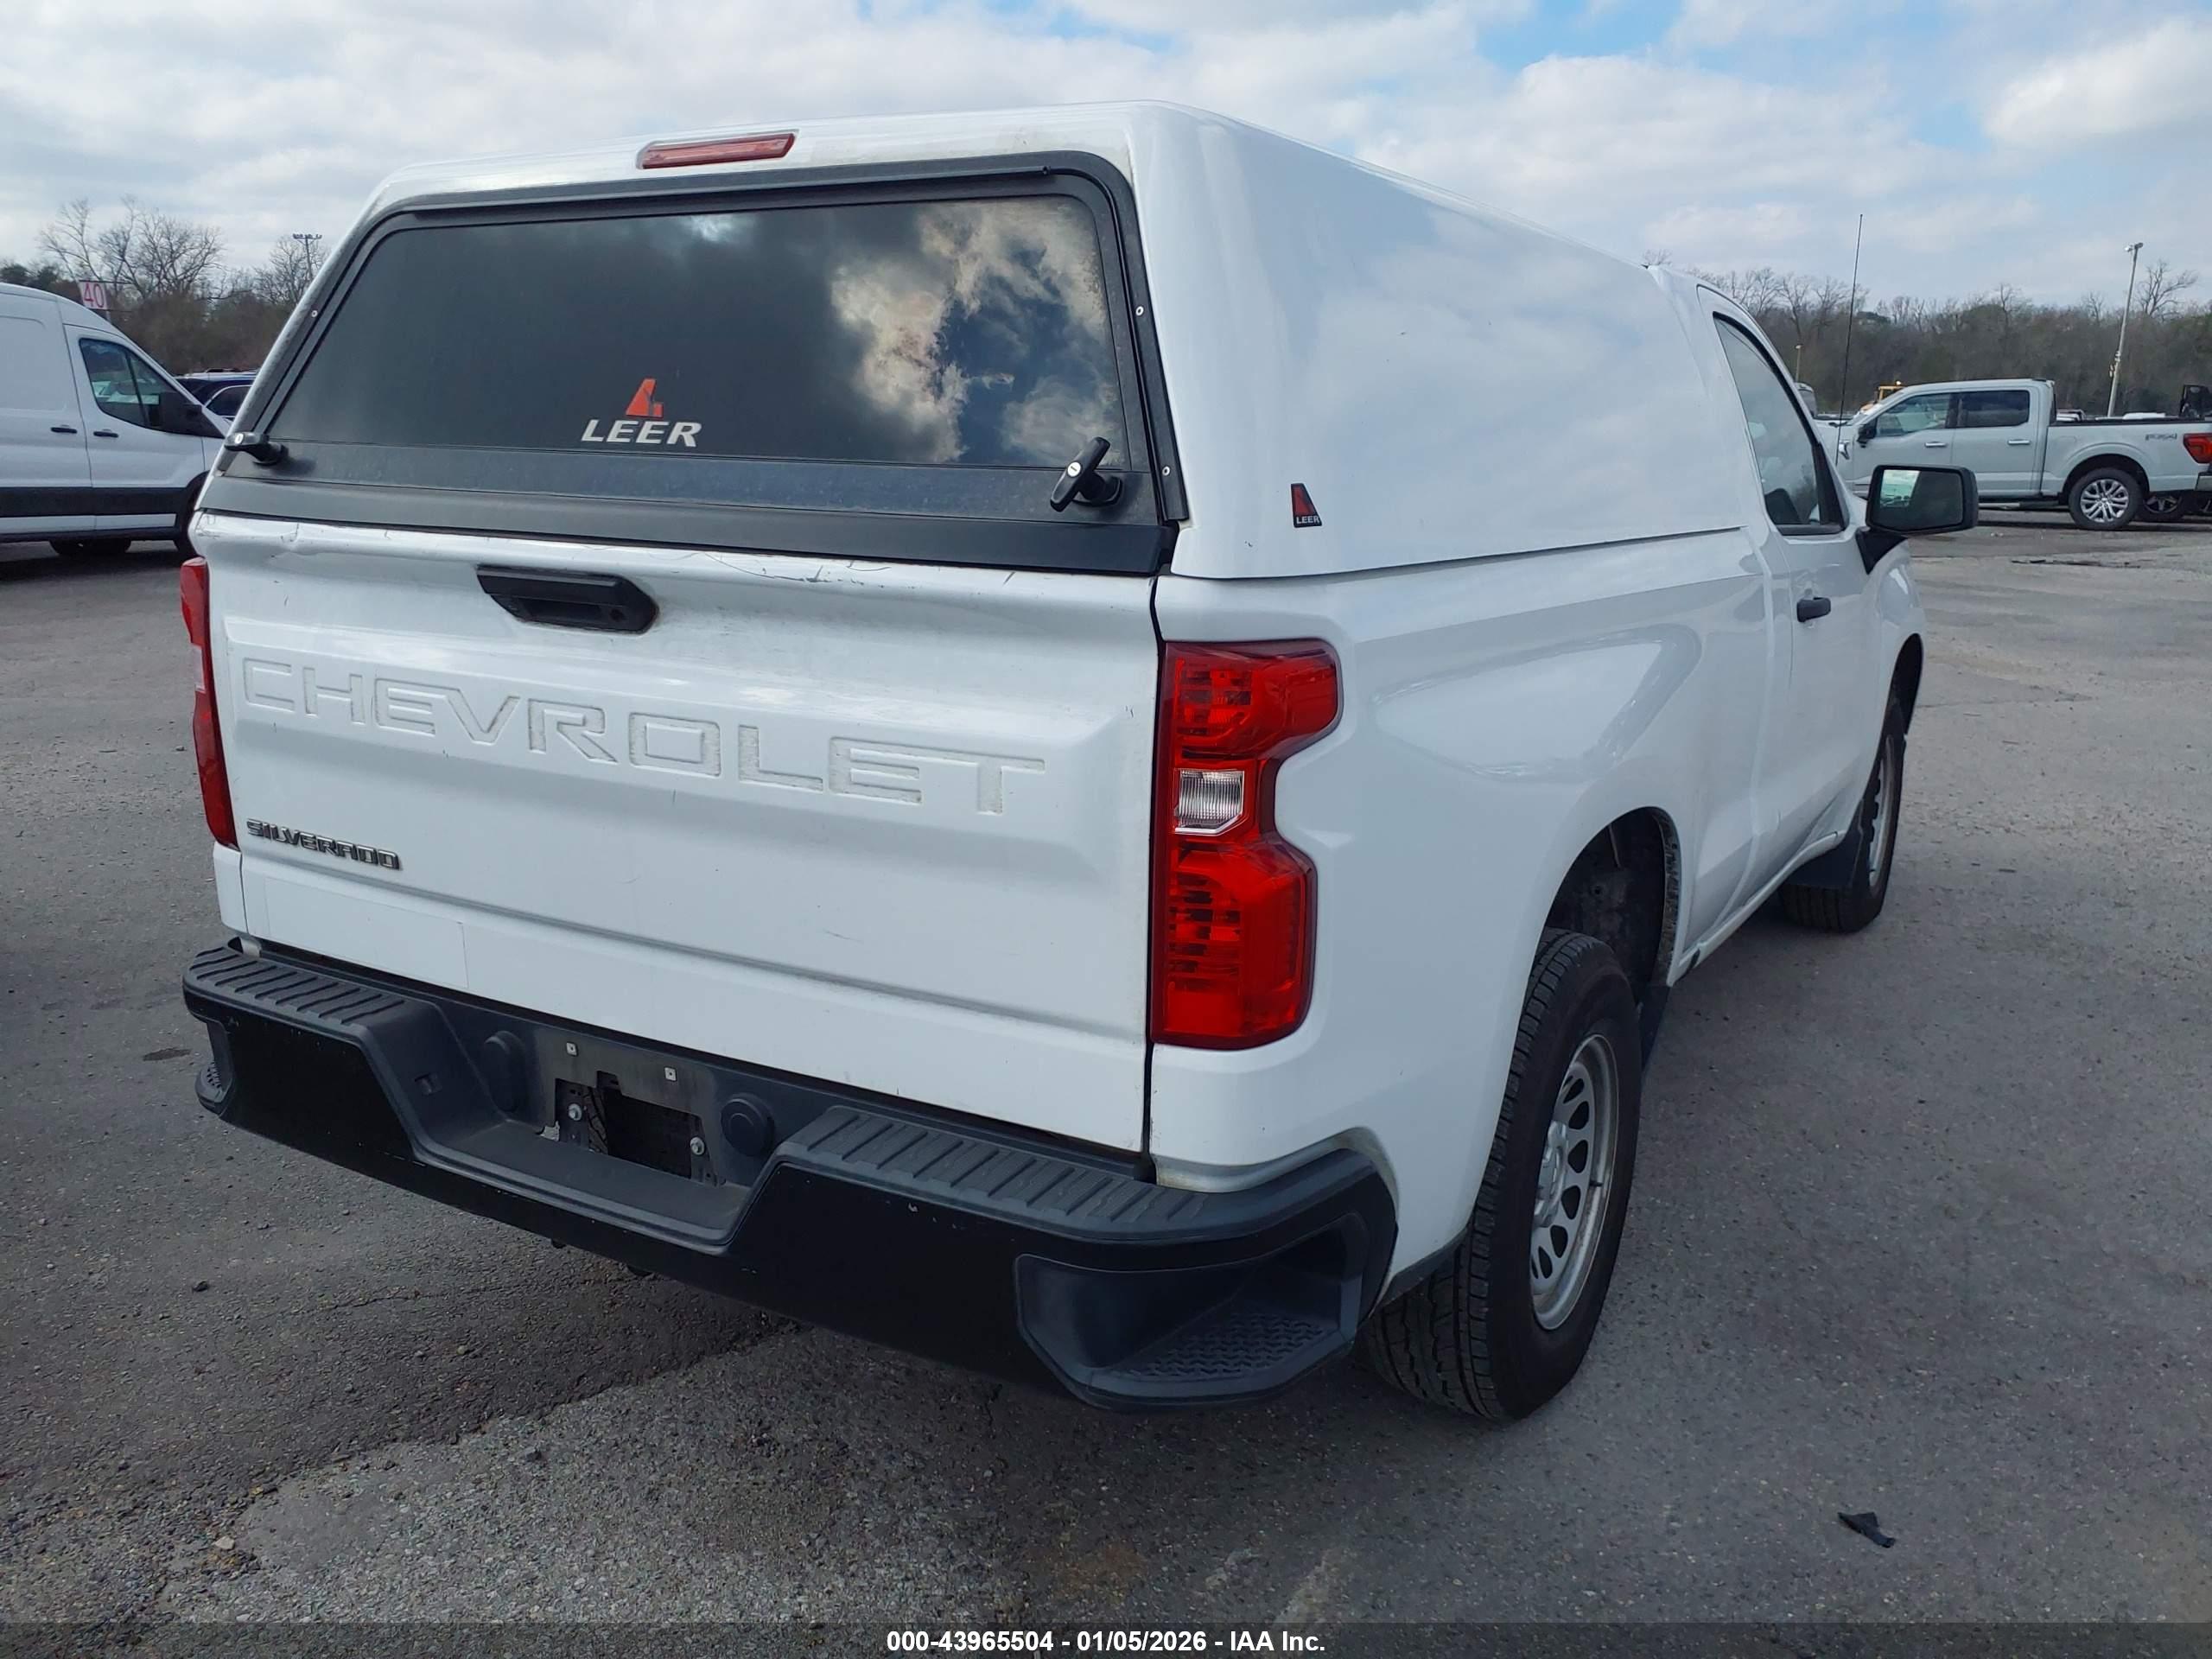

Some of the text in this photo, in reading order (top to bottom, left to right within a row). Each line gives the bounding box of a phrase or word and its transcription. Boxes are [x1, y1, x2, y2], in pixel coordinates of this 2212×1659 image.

[84, 283, 105, 308] 40
[581, 419, 702, 447] LEER
[242, 657, 1046, 815] CHEVROLET
[246, 818, 401, 870] SILVERADO
